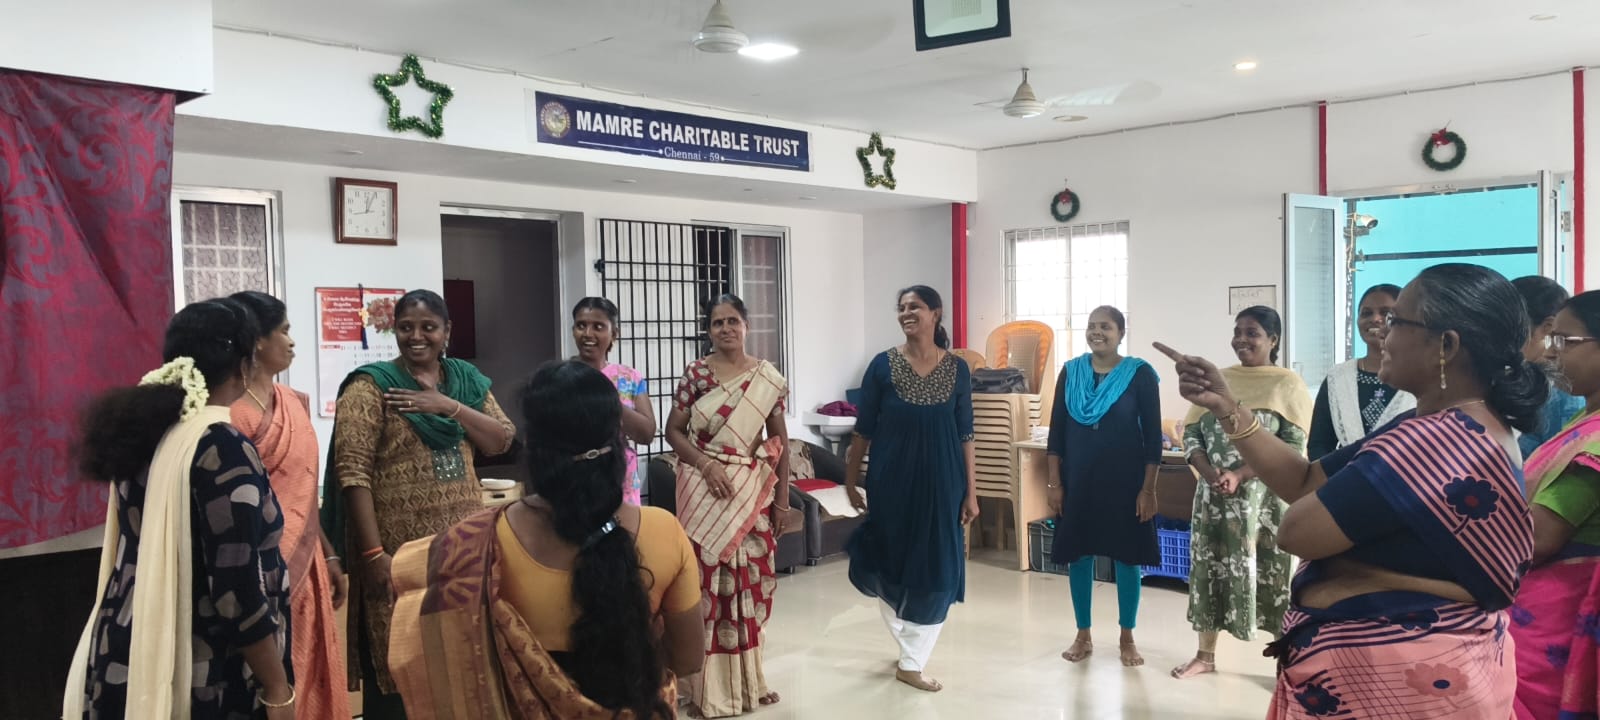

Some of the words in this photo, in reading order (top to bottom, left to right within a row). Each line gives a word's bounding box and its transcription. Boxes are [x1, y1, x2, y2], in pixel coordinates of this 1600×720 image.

[576, 110, 644, 138] MAMRE
[649, 121, 750, 151] CHARITABLE
[753, 135, 800, 157] TRUST
[664, 146, 701, 160] Chennai
[709, 152, 721, 162] 59
